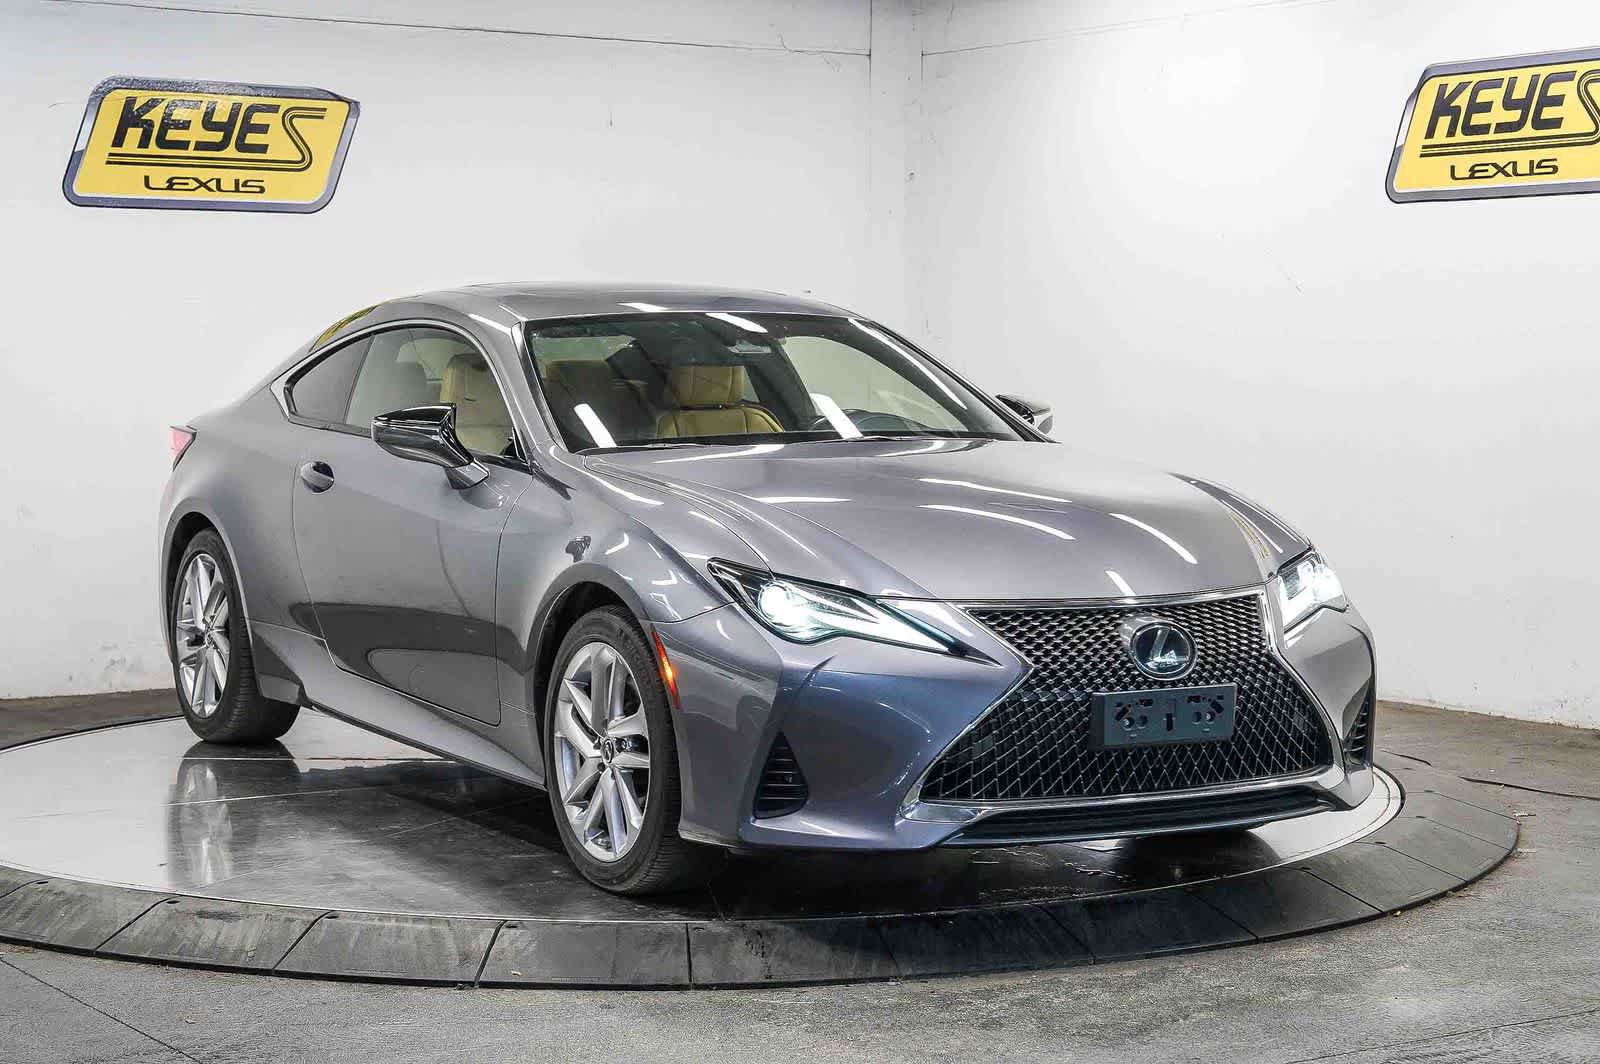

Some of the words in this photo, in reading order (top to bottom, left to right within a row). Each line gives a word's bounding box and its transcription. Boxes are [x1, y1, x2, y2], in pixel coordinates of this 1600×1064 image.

[107, 96, 327, 170] KEYES
[1450, 158, 1559, 180] LEXUS
[144, 175, 265, 193] LEXUS
